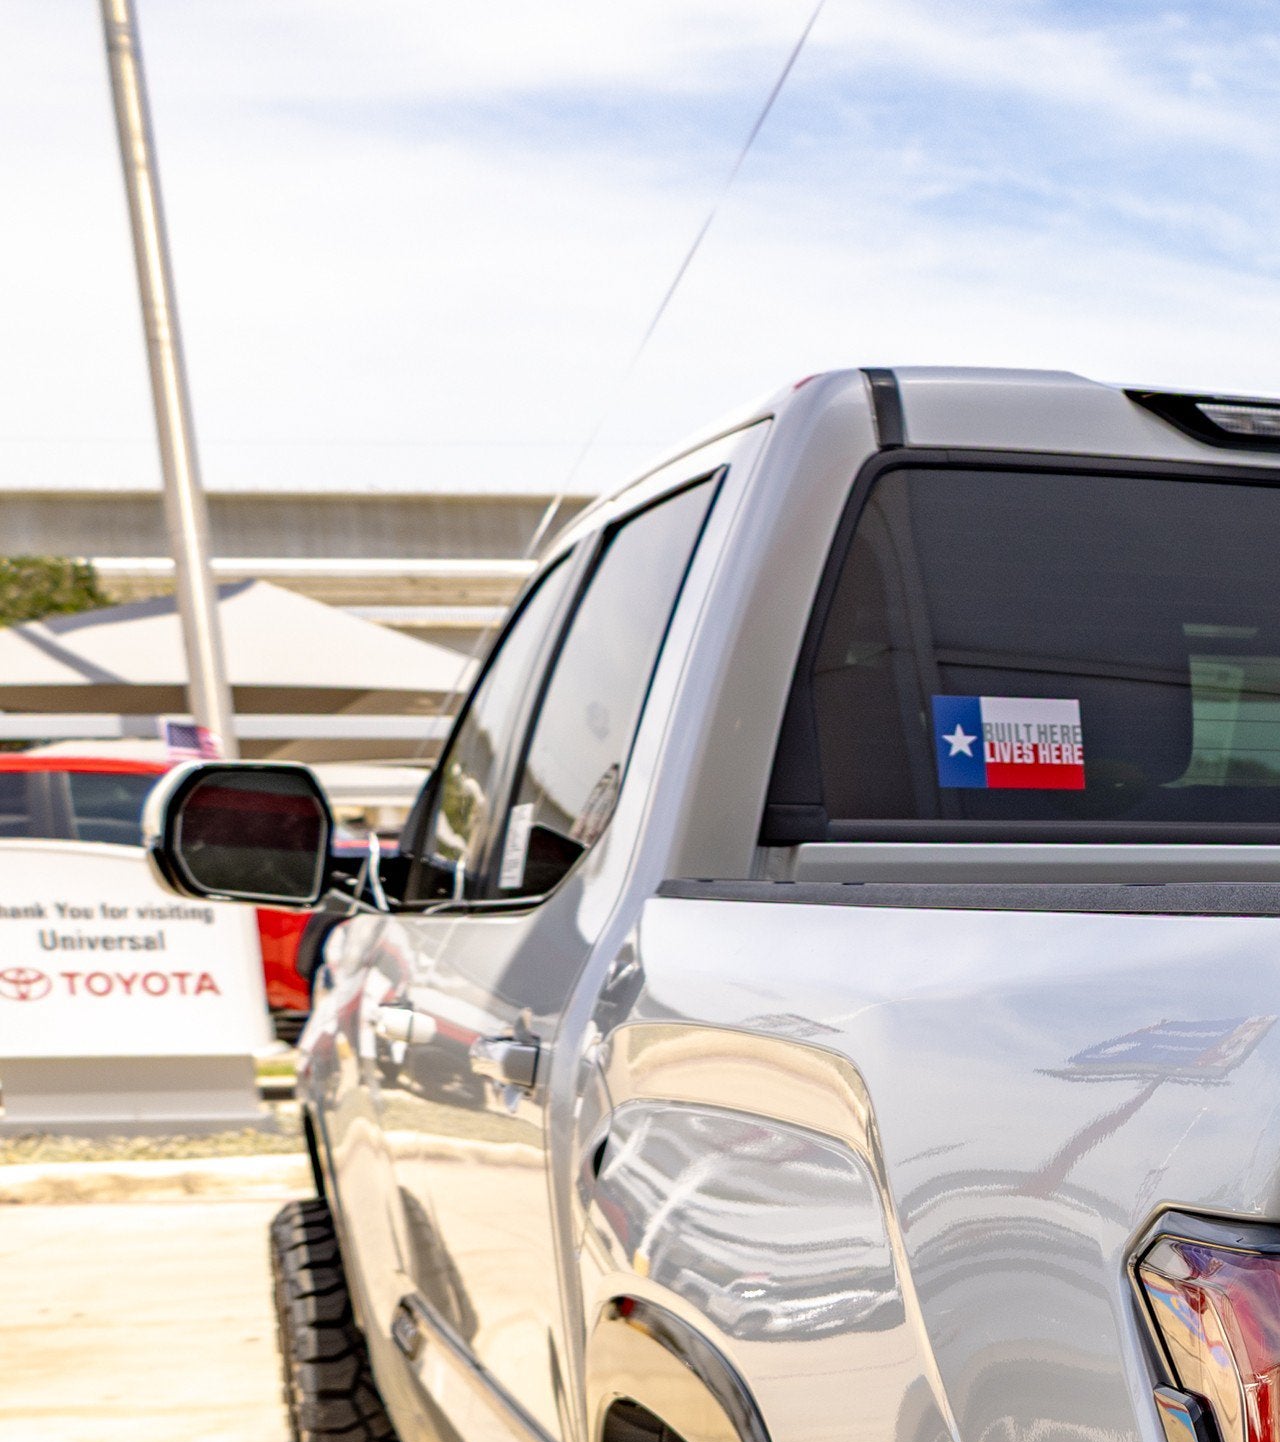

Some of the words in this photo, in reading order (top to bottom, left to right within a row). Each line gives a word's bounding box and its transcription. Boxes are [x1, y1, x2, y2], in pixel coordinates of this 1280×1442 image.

[983, 722, 1033, 744] BUILT
[1037, 724, 1083, 744] HERE
[985, 742, 1034, 764] LIVES
[1038, 743, 1084, 765] HERE
[0, 902, 47, 920] hank
[55, 902, 94, 920] You
[100, 902, 128, 920] for
[137, 903, 214, 924] visiting
[39, 929, 165, 951] Universal
[60, 971, 221, 996] TOYOTA
